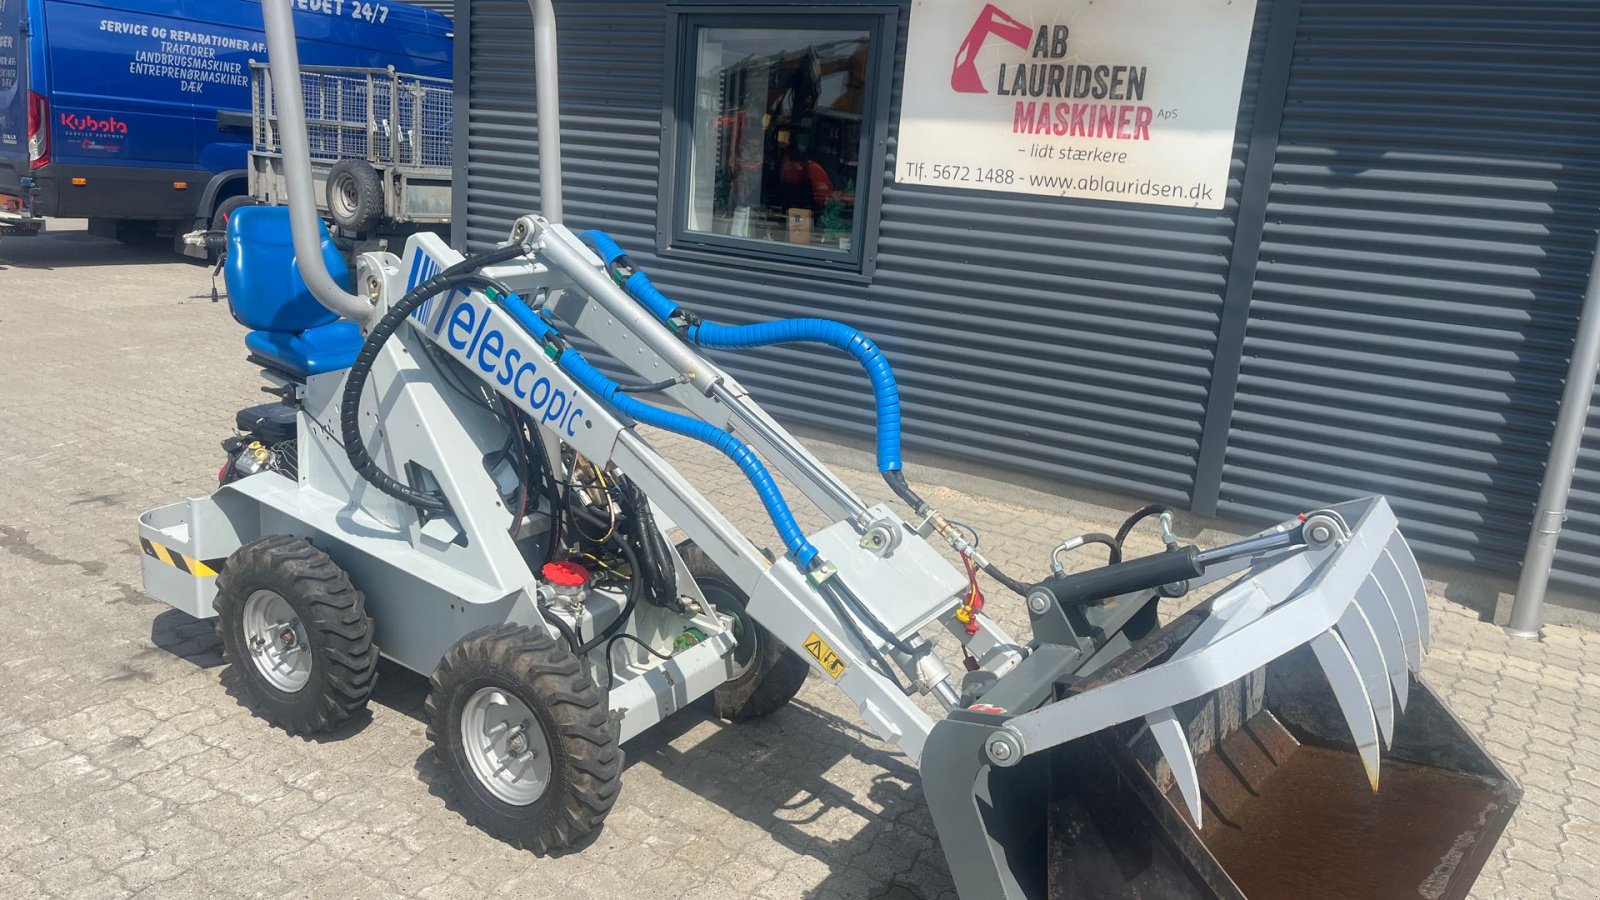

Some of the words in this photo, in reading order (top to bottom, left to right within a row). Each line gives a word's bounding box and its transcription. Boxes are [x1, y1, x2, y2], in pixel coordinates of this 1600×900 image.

[290, 0, 344, 15] EDET
[351, 1, 389, 24] 24/7
[100, 19, 148, 36] SERVICE
[151, 27, 167, 39] OG
[170, 29, 249, 51] REPARATIONER
[251, 41, 267, 54] AF:
[1032, 24, 1069, 58] AB
[135, 50, 242, 74] LANDBRUGSMASKINER
[161, 41, 215, 59] TRAKTORER
[129, 62, 248, 87] ENTREPRENØRMASKINER
[180, 80, 203, 94] DÆK
[997, 63, 1147, 101] LAURIDSEN
[61, 113, 128, 134] Kubota
[1012, 100, 1153, 141] MASKINER
[1157, 108, 1179, 121] ApS
[1030, 143, 1054, 159] lidt
[1058, 146, 1127, 164] stærkere
[906, 162, 927, 181] Tlf.
[933, 164, 970, 182] 5672
[975, 167, 1015, 185] 1488
[1029, 174, 1213, 201] www.ablauridsen.dk
[433, 283, 583, 437] Telescopic
